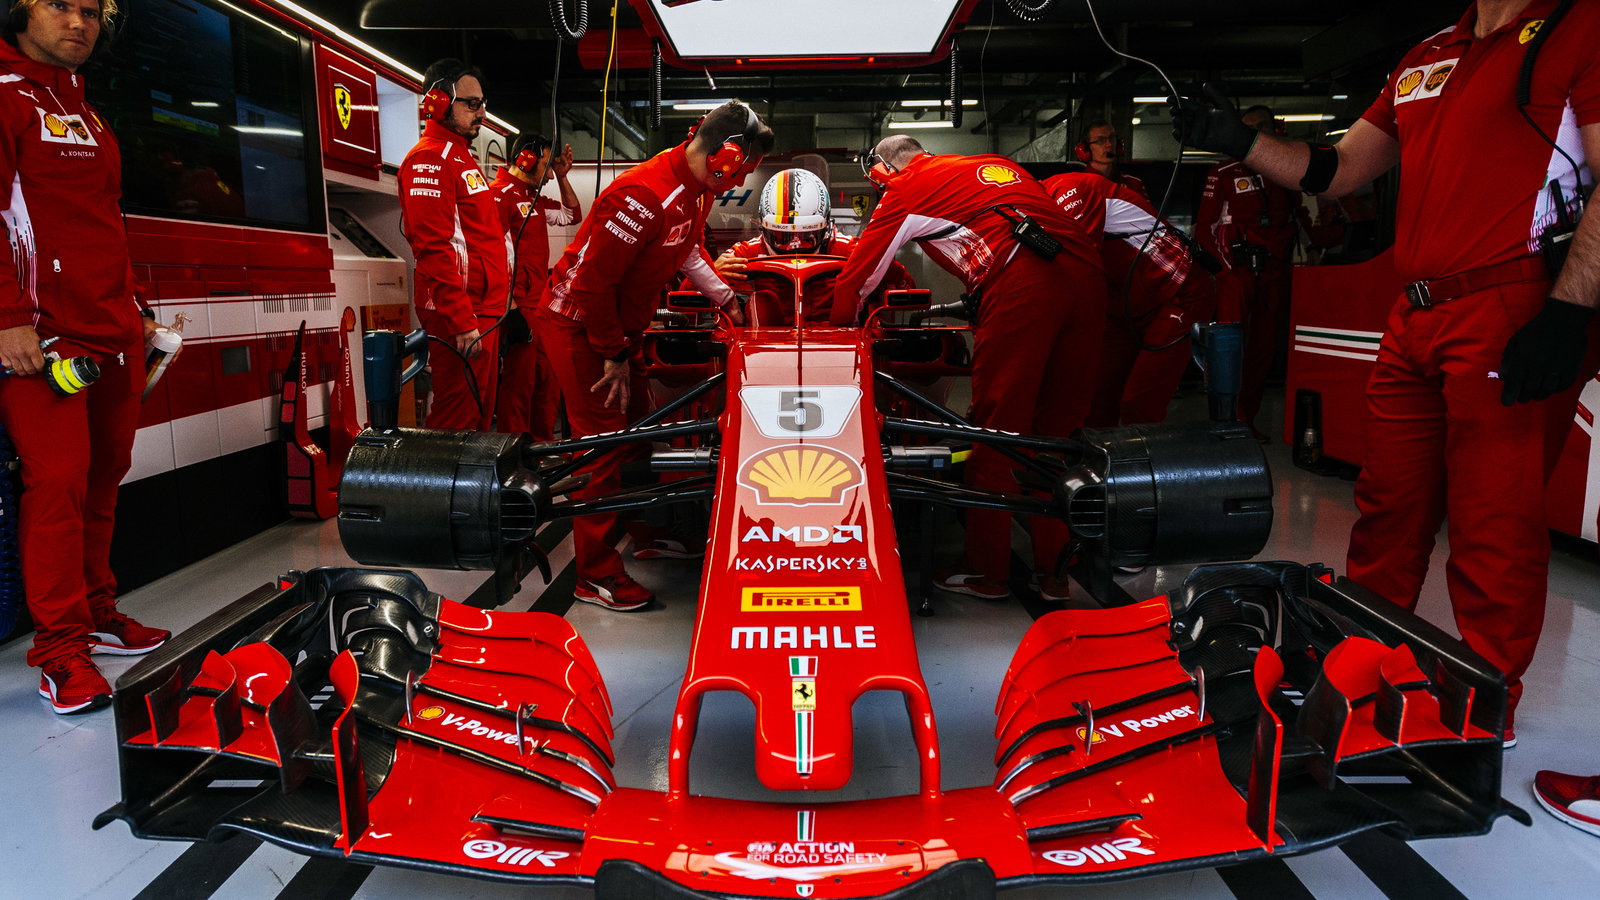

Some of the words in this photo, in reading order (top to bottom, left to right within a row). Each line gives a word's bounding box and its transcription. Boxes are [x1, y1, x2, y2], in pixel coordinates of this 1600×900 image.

[1427, 72, 1449, 88] ups
[413, 177, 439, 185] MAHLE
[410, 188, 441, 198] PIRELLI
[1056, 188, 1077, 205] BLOT
[624, 195, 655, 220] WEICHAI
[615, 211, 644, 233] MAHLE
[605, 220, 638, 245] PIRELLI
[777, 390, 824, 432] 5
[741, 525, 830, 543] AMD
[735, 555, 855, 573] KASPERSKY
[752, 591, 850, 606] PIRELLI
[731, 626, 877, 649] MAHLE
[1100, 726, 1124, 738] V
[1122, 704, 1196, 733] Power
[779, 842, 855, 854] ACTION
[747, 853, 770, 861] FOR
[774, 854, 819, 864] ROAD
[823, 853, 887, 864] SAFETY
